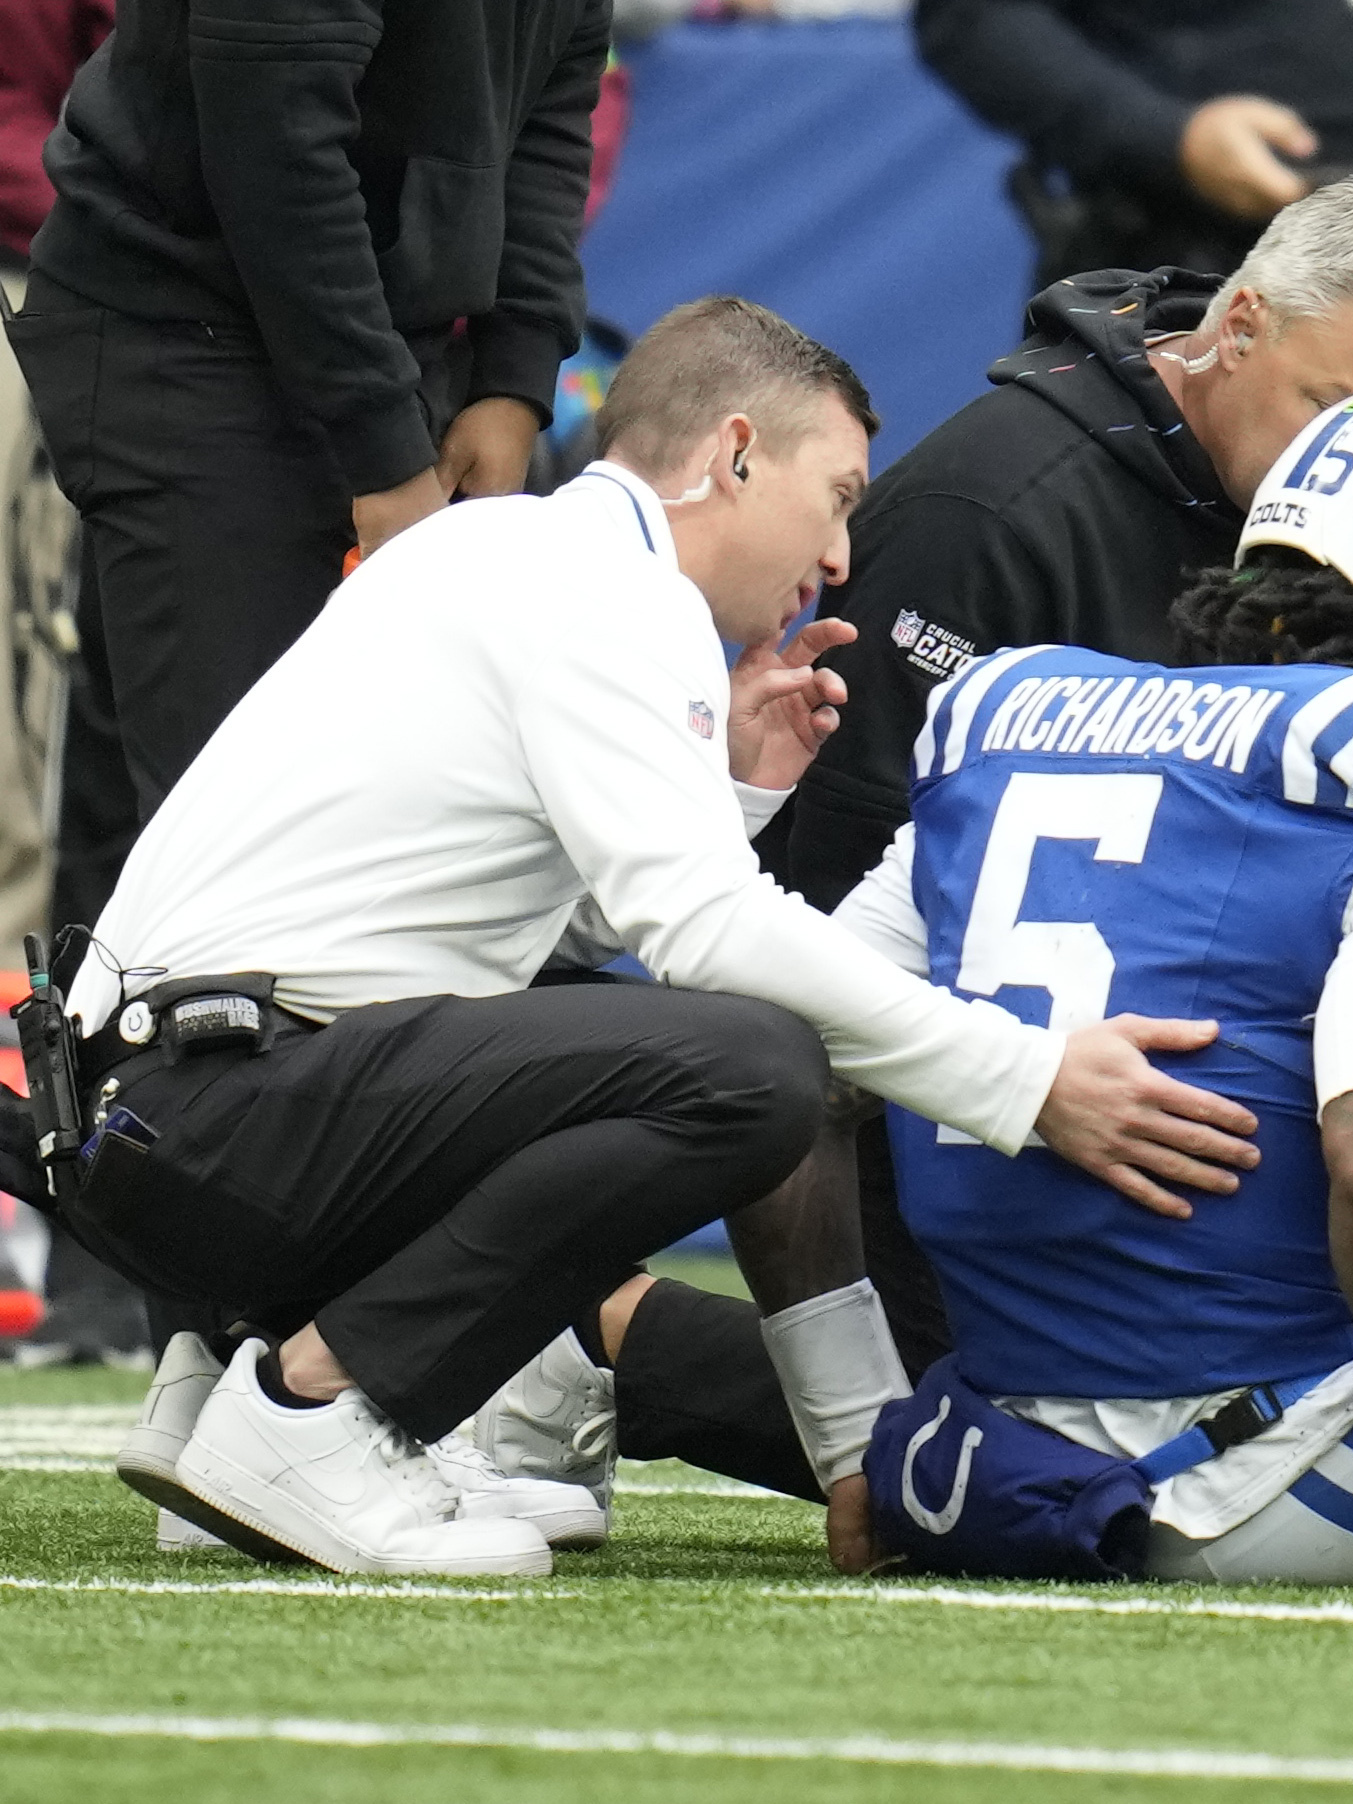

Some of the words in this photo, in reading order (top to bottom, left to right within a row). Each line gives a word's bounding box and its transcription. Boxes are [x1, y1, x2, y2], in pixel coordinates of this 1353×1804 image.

[1249, 502, 1311, 529] COLTS
[895, 624, 915, 643] NFL
[925, 623, 976, 654] CRUCIAL
[913, 634, 975, 672] CATC
[981, 676, 1286, 774] RICHARDSON
[937, 771, 1163, 1147] 5
